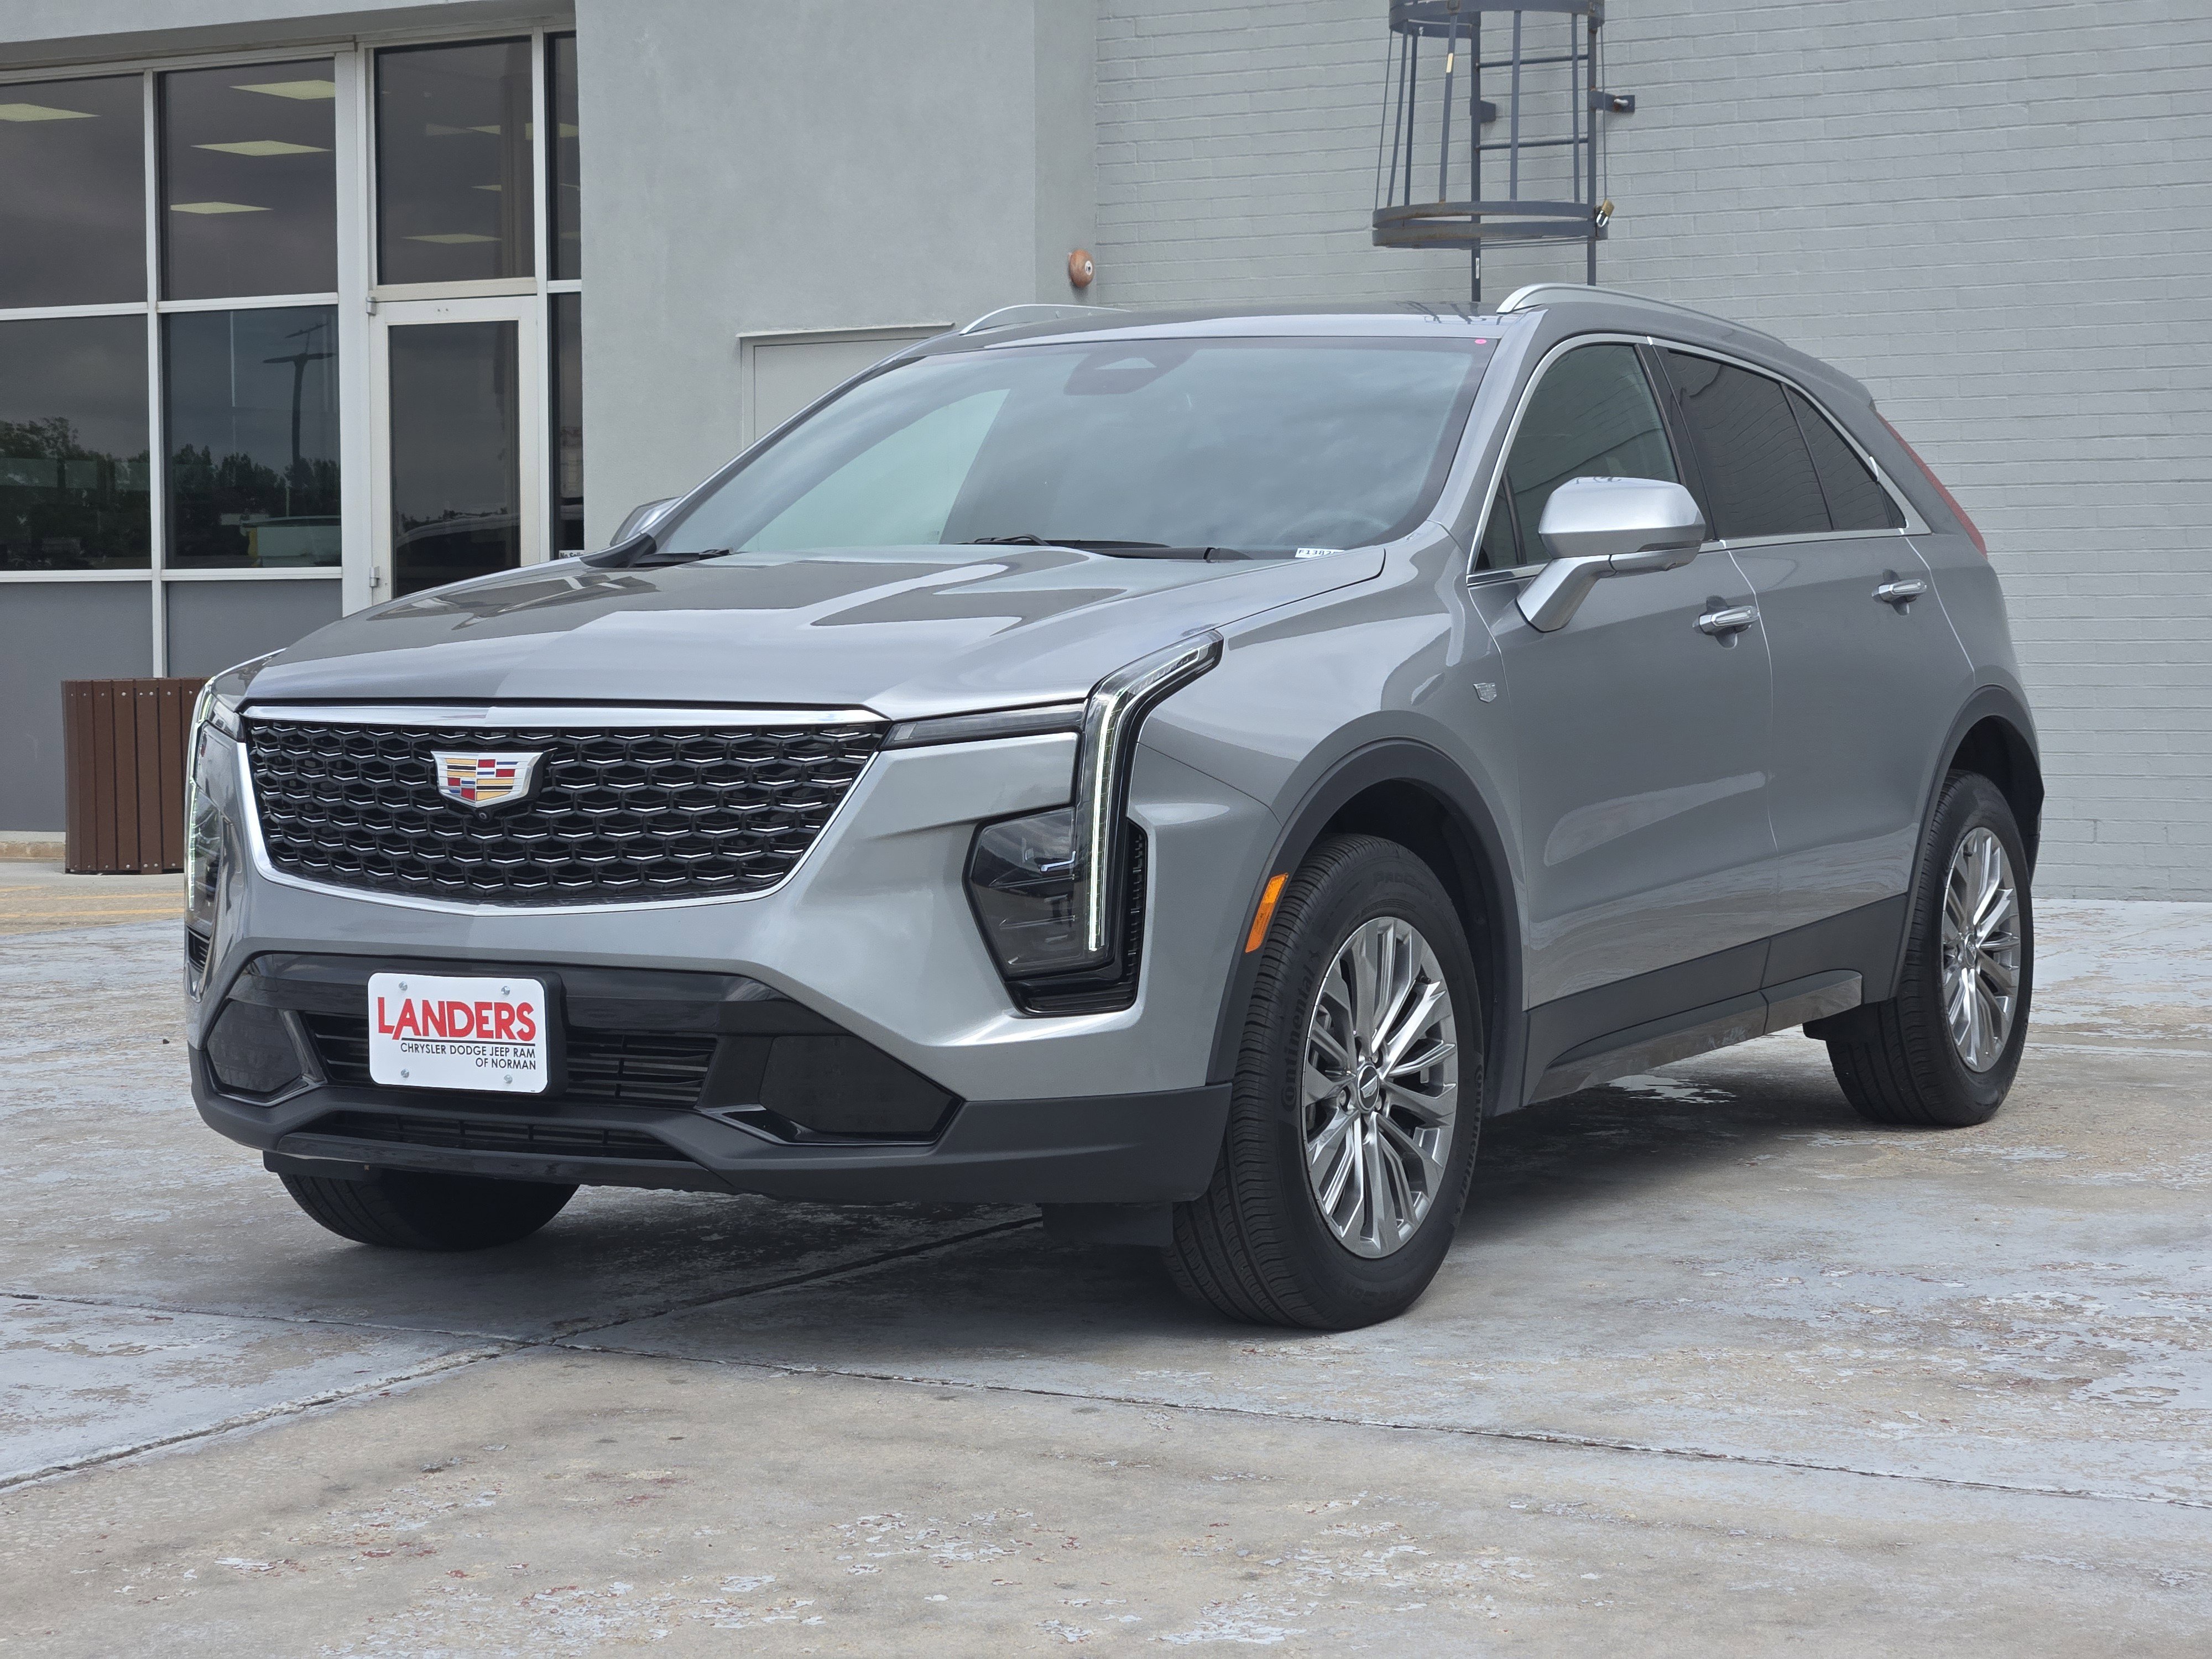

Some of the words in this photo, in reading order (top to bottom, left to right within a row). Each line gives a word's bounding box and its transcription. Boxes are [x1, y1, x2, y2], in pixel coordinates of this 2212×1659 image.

[378, 997, 536, 1042] LANDERS
[400, 1042, 446, 1054] CHRYSLER
[450, 1045, 487, 1056] DODGE
[489, 1047, 510, 1057] JEEP
[513, 1048, 535, 1058] RAM
[1281, 964, 1315, 1112] Continental
[476, 1058, 489, 1068] OF
[491, 1058, 536, 1070] NORMAN
